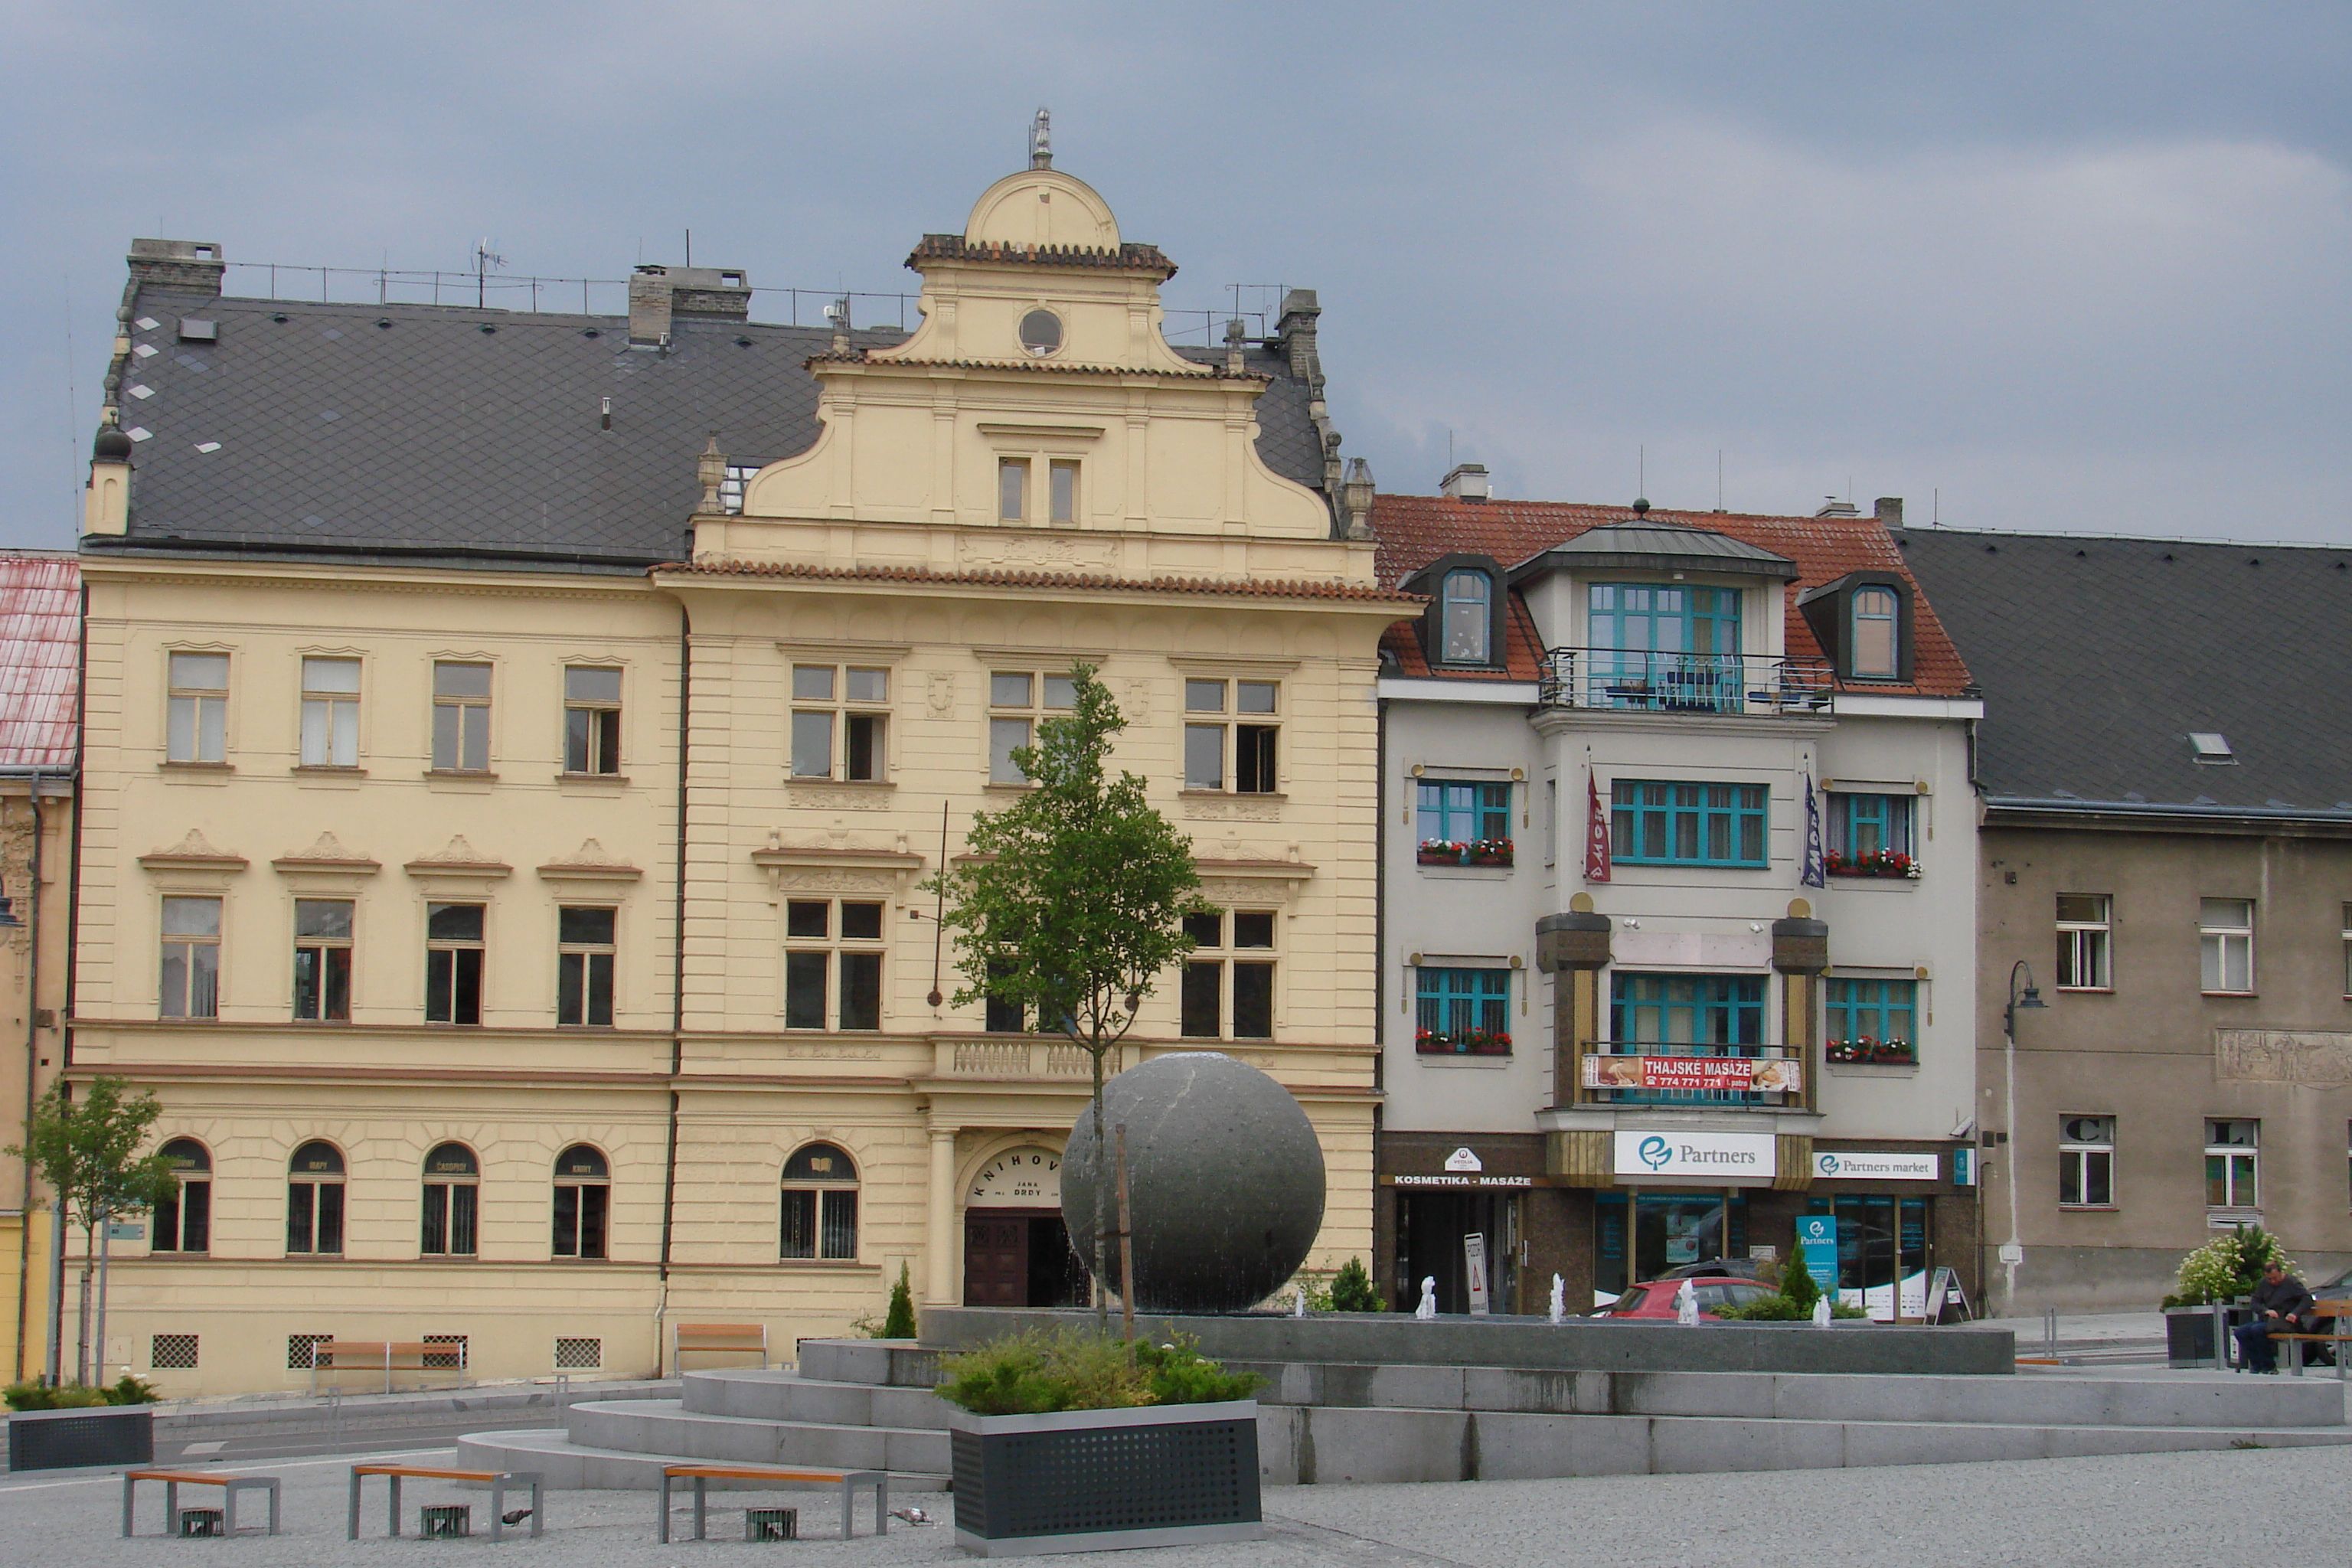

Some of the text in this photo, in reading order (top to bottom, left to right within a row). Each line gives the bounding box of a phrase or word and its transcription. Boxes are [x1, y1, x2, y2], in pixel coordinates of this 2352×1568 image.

[1645, 1060, 1751, 1076] THAJSKÉ MASÁŽE
[1660, 1077, 1679, 1086] 774
[1681, 1077, 1700, 1086] 771
[1703, 1078, 1721, 1086] 771
[1680, 1145, 1756, 1164] Partners
[1844, 1160, 1929, 1173] Partners market
[974, 1155, 1058, 1197] KNIHOV
[1394, 1175, 1469, 1184] KOSMETIKA
[1479, 1176, 1531, 1186] MASÁŽE
[1800, 1236, 1834, 1245] Partners
